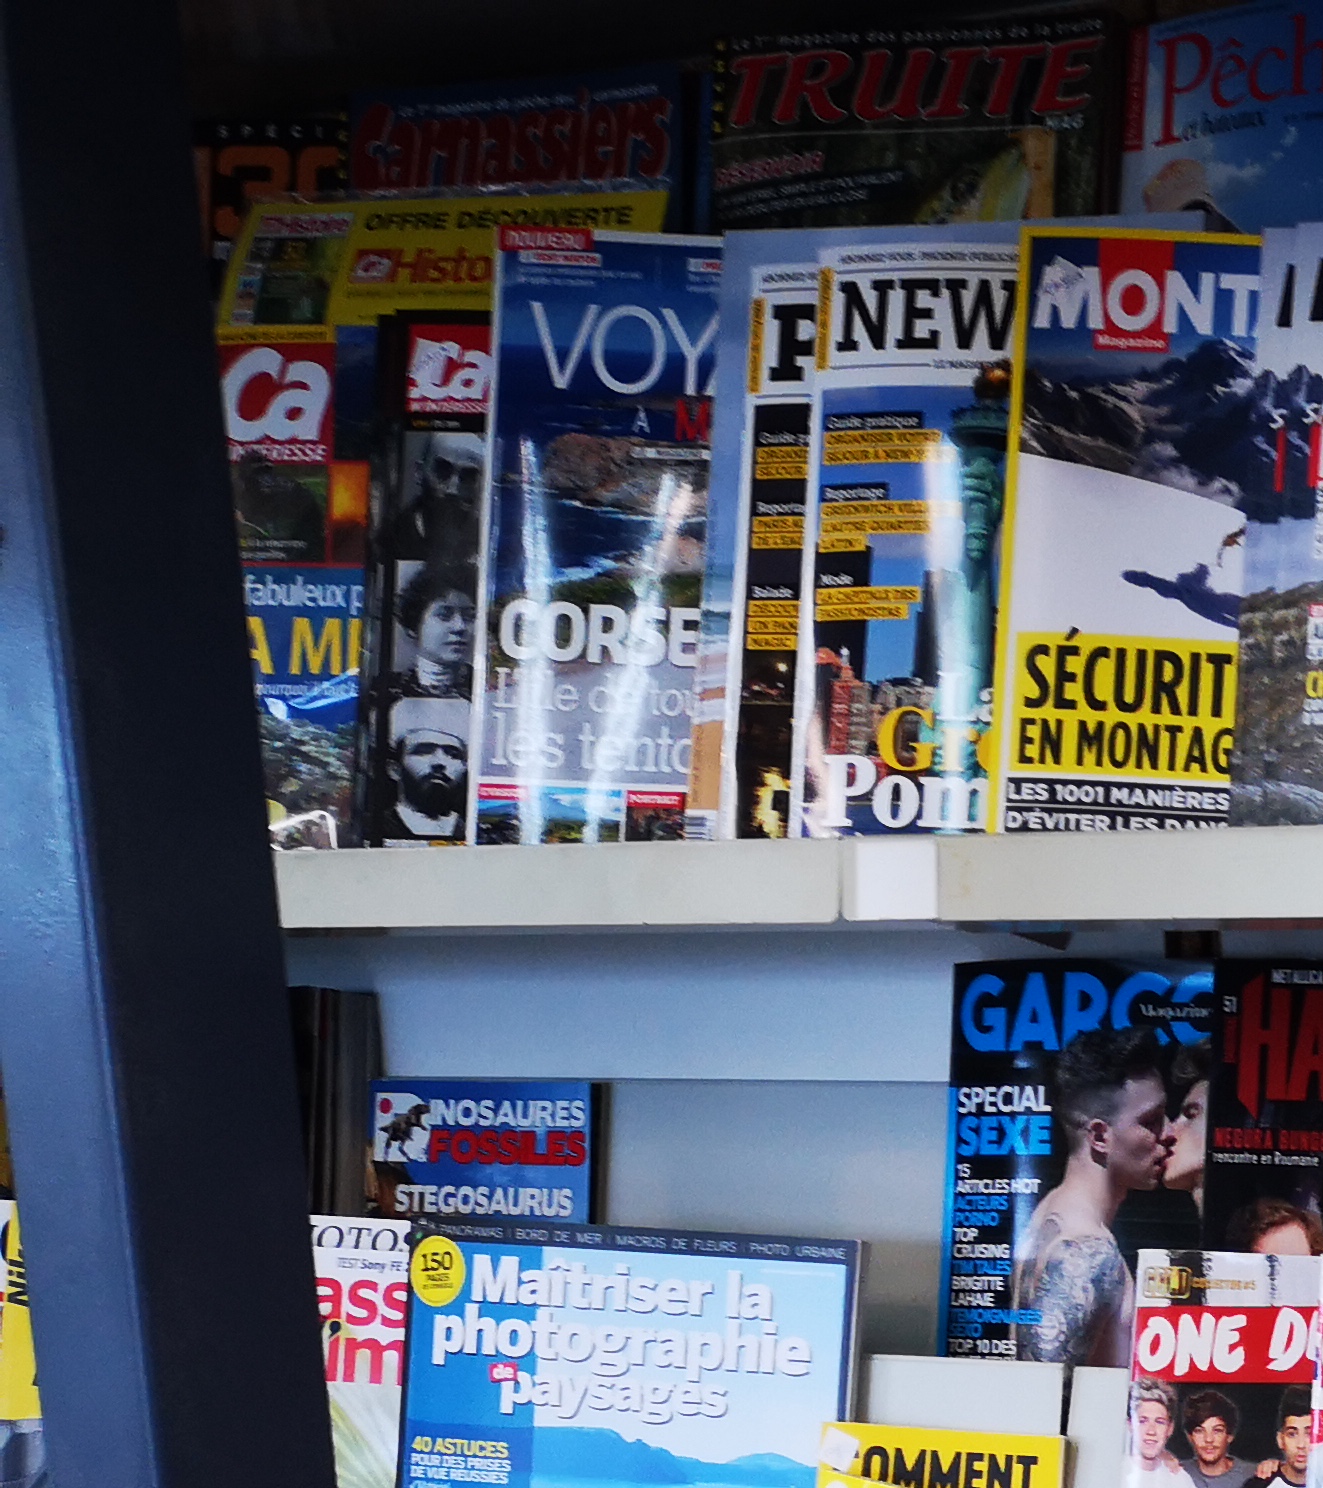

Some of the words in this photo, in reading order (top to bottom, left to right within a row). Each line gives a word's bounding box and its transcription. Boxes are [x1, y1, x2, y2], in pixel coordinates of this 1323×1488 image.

[727, 34, 1106, 129] TRUITE
[364, 211, 451, 231] OFFRE
[501, 599, 699, 669] CORSE
[1018, 718, 1063, 766] EN
[1008, 781, 1048, 801] LES
[1055, 783, 1105, 804] 1001
[1111, 784, 1229, 811] MANIÈRES
[958, 1085, 1052, 1114] SPECIAL
[429, 1131, 586, 1166] FOSSILES
[957, 1116, 1052, 1156] SEXE
[395, 1183, 573, 1218] STEGOSAURUS
[420, 1251, 453, 1271] 150
[471, 1254, 714, 1321] Maîtriser
[727, 1270, 772, 1322] la
[431, 1306, 812, 1379] photographie
[1136, 1314, 1248, 1379] ONE
[492, 1364, 515, 1381] de
[500, 1368, 729, 1425] paysages
[412, 1436, 433, 1455] 40
[436, 1437, 508, 1459] ASTUCES
